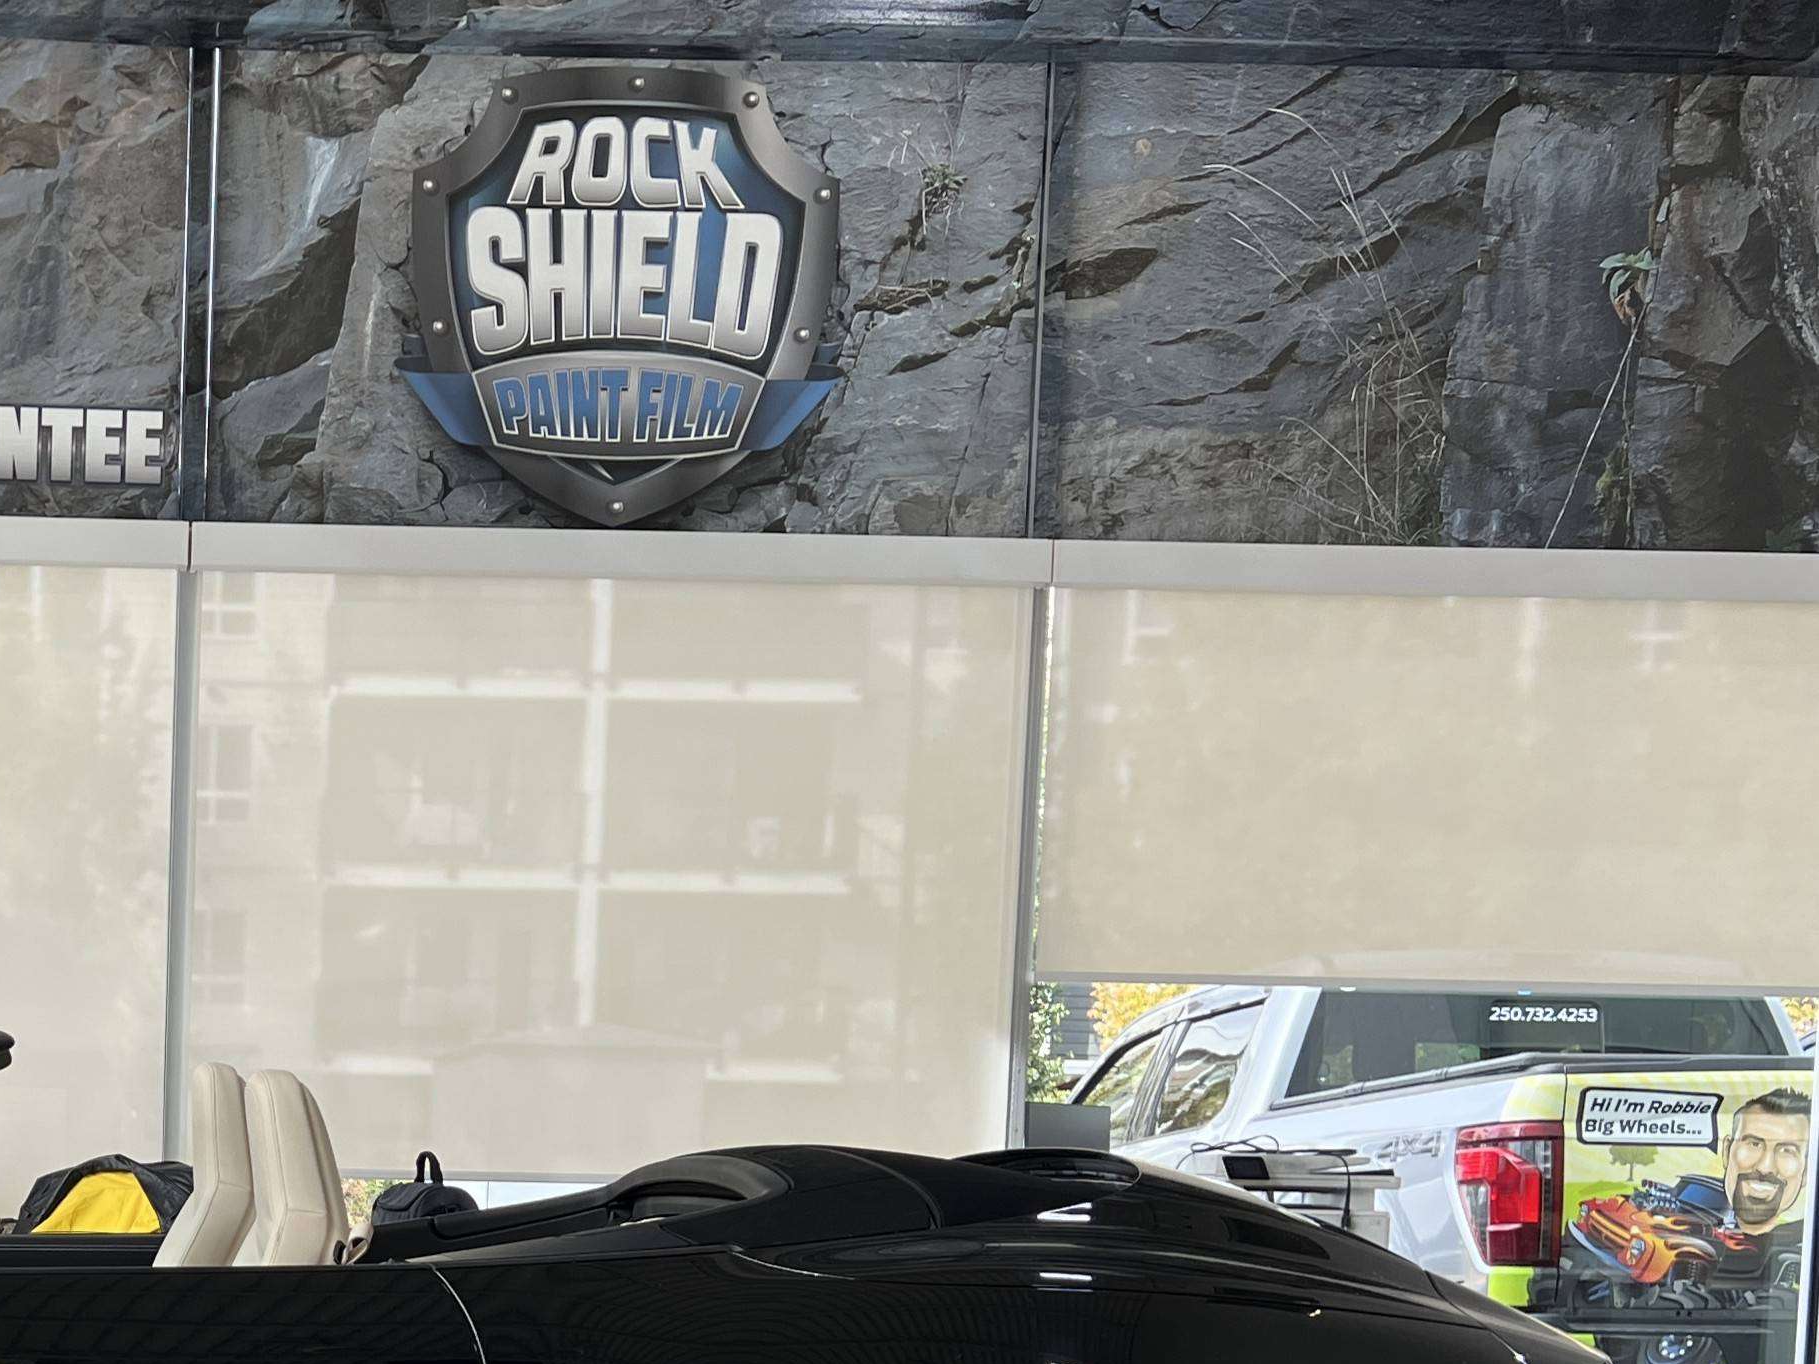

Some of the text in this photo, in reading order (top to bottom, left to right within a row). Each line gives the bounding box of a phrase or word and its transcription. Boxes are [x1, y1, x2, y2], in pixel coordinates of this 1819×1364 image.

[507, 116, 744, 209] ROCK
[467, 206, 782, 360] SHIELD
[493, 366, 744, 443] PAINT FILM
[1489, 1006, 1599, 1023] 250.732.4253
[1585, 1118, 1702, 1135] Big Wheels...
[1590, 1097, 1712, 1114] Hi I'm Robbie
